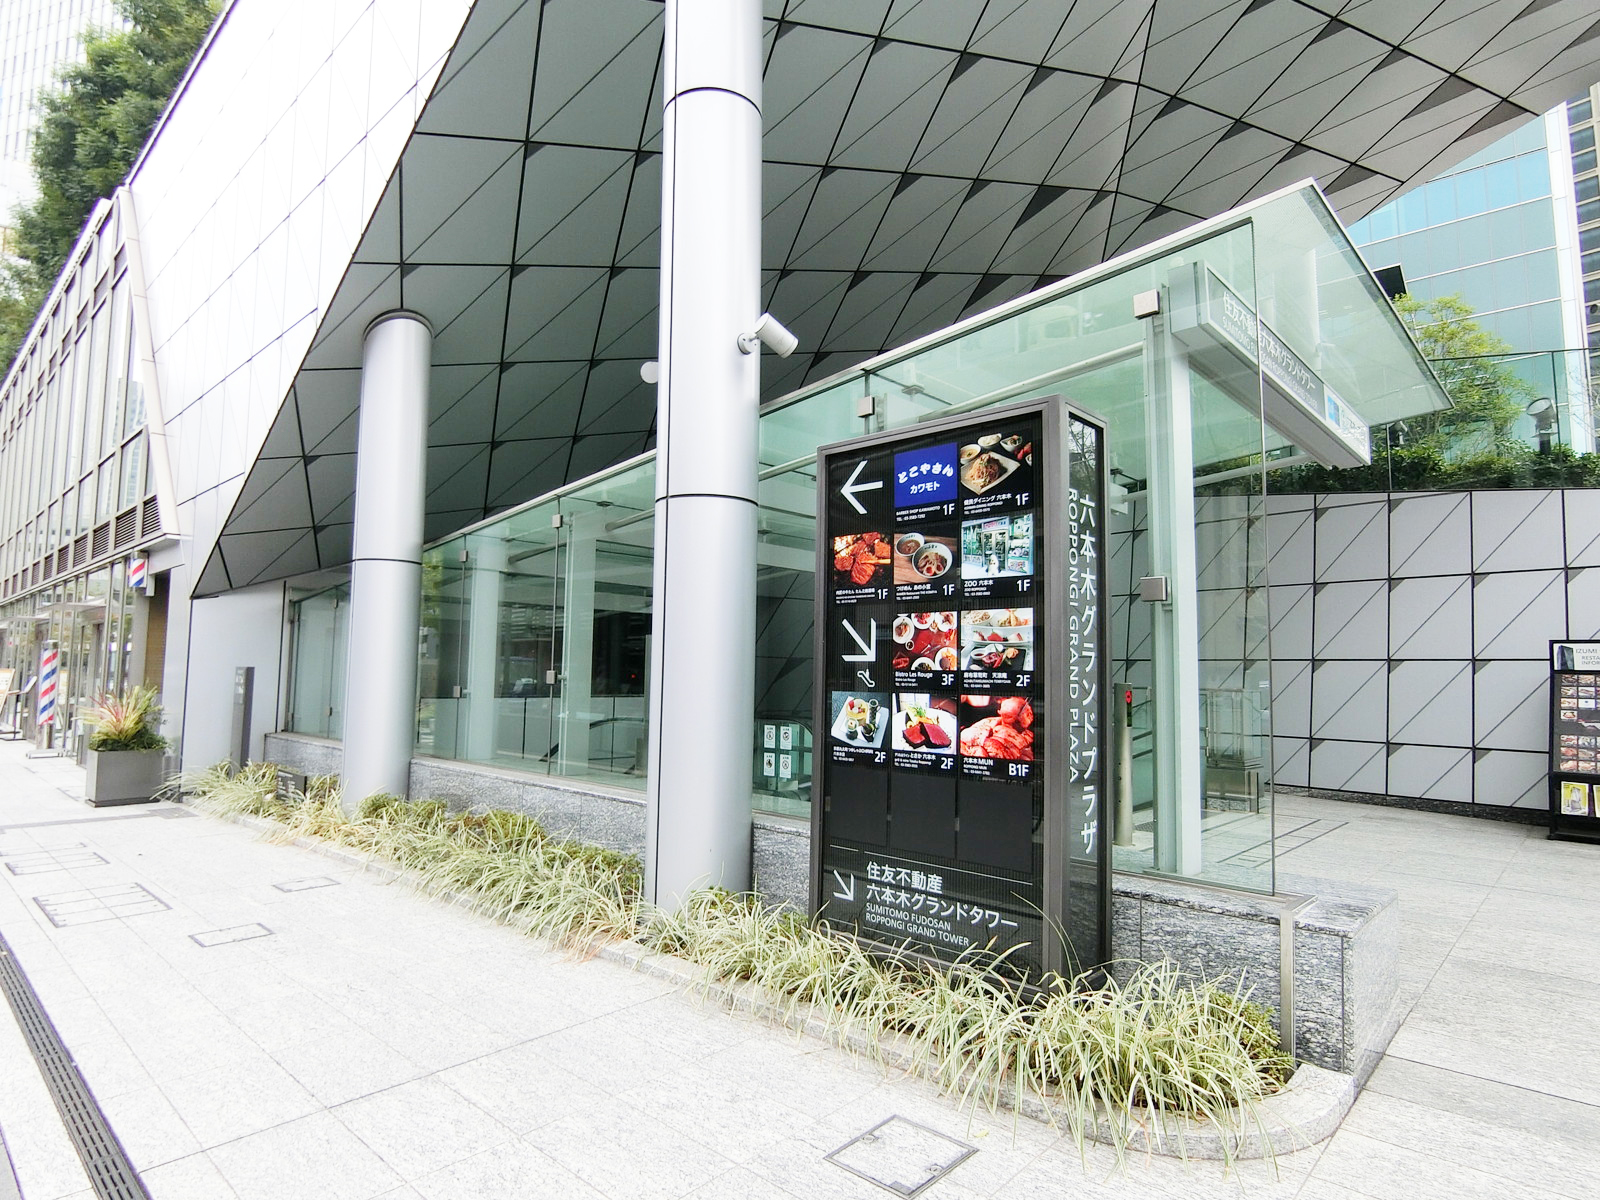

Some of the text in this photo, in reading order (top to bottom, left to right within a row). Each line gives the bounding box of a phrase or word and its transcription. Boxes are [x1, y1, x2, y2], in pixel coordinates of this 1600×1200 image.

[897, 462, 954, 484] とこやさん
[910, 481, 941, 494] カワモト
[1015, 493, 1029, 506] 1F
[942, 503, 955, 516] 1F
[942, 583, 955, 596] 1F
[964, 580, 978, 588] ZOO
[1016, 579, 1031, 592] 1F
[877, 588, 889, 600] 1F
[1068, 487, 1080, 783] ROPPONGI GRAND PLAZA
[941, 673, 955, 686] 3F
[1015, 674, 1031, 687] 2F
[1079, 493, 1098, 855] 六本木グランドプラザ
[874, 751, 887, 763] 2F
[940, 757, 954, 770] 2F
[1008, 762, 1030, 777] B1F
[866, 861, 943, 894] 住友不動産
[866, 883, 1018, 928] 六本木グランドタワー
[866, 902, 951, 931] SUMITOMO FUDOSAN
[865, 912, 970, 946] ROPPONGI GRAND TOWER
